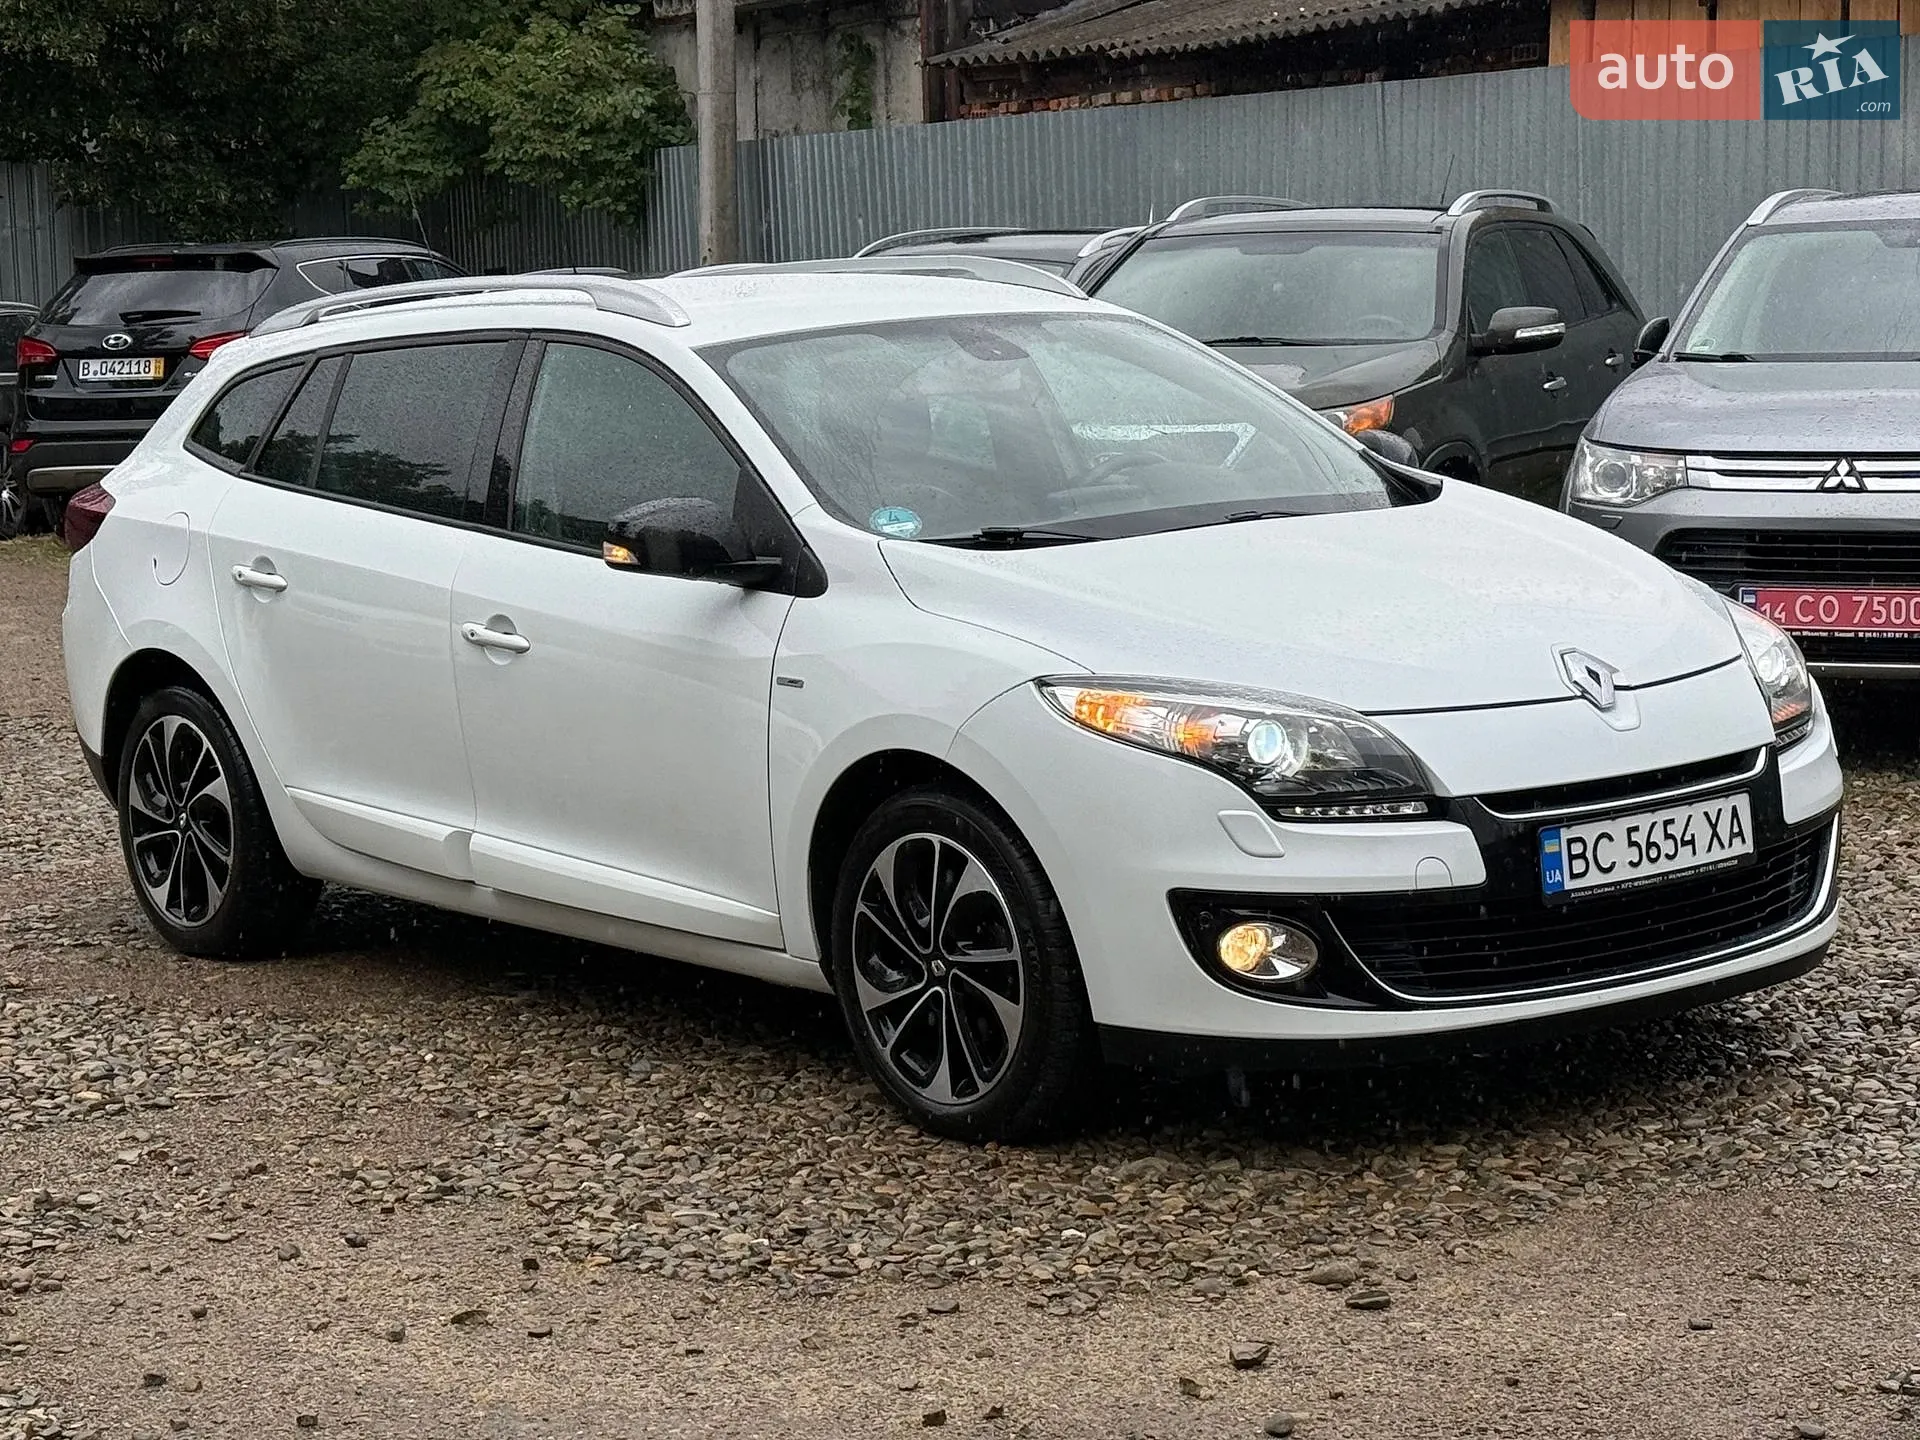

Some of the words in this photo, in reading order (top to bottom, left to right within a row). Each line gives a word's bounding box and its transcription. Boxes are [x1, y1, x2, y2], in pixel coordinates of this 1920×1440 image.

[1760, 602, 1786, 624] 14
[1794, 594, 1840, 624] CO
[1852, 595, 1920, 625] 7500
[1566, 831, 1617, 881] BC
[1626, 814, 1698, 869] 5654
[1703, 804, 1747, 853] XA
[1546, 868, 1563, 884] UA
